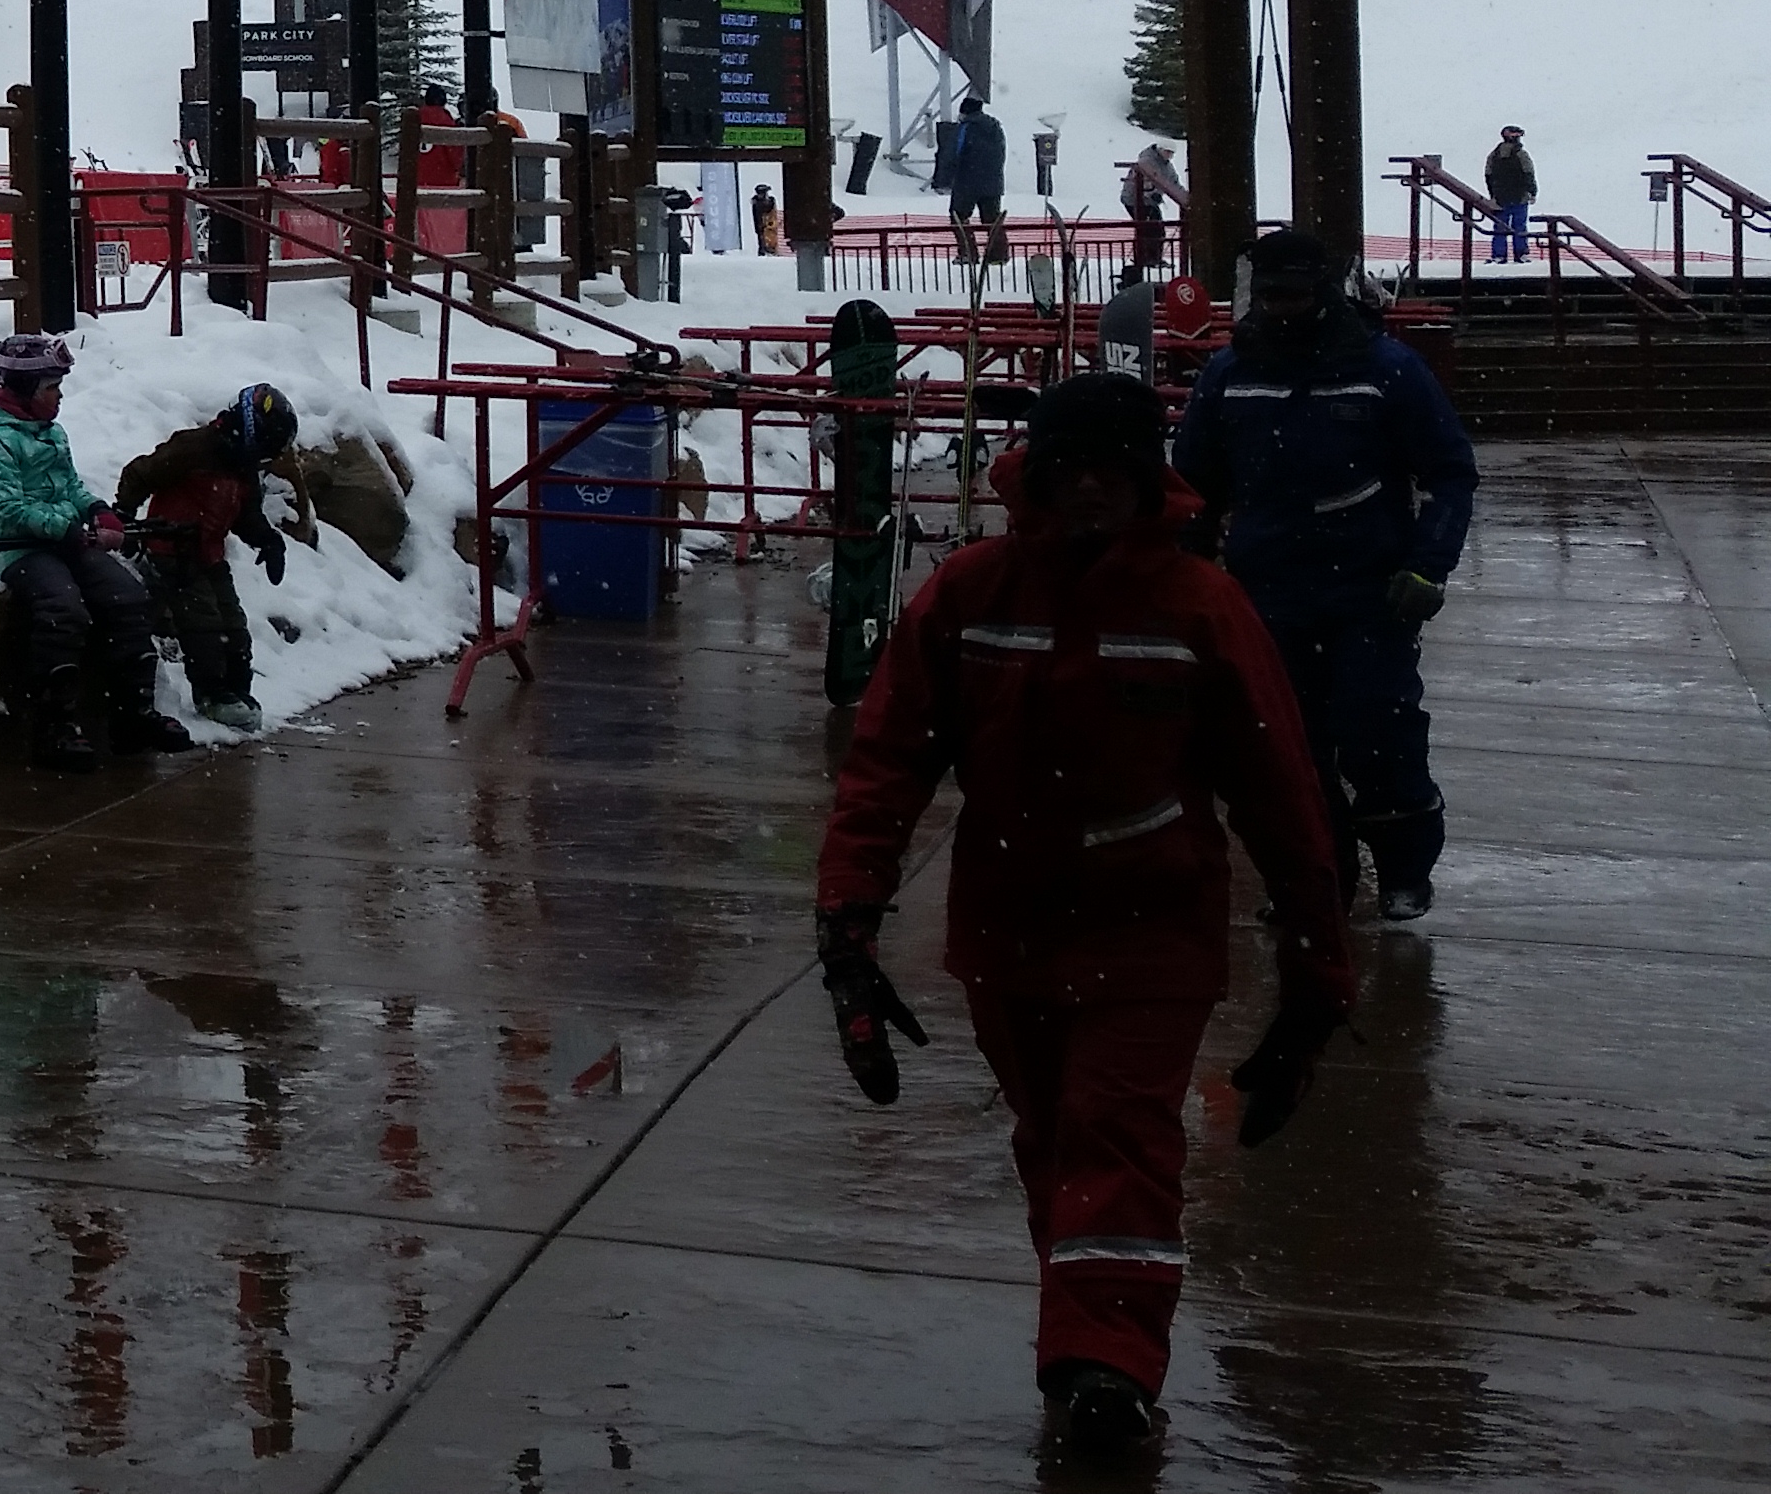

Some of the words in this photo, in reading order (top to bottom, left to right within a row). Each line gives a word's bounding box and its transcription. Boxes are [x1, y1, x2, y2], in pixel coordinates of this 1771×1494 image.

[243, 31, 278, 41] PARK
[282, 30, 315, 40] CITY
[839, 366, 891, 392] MOD
